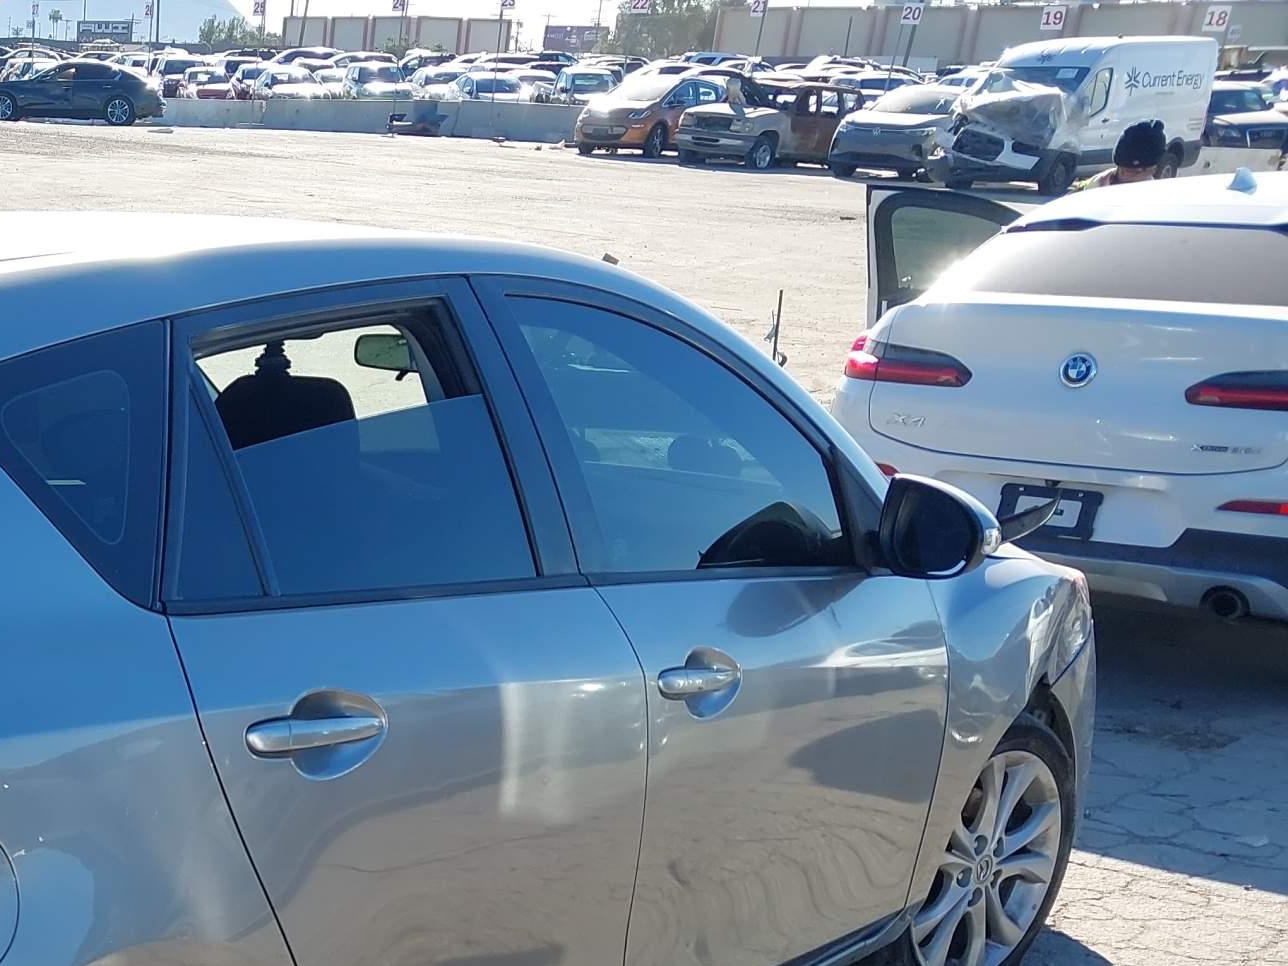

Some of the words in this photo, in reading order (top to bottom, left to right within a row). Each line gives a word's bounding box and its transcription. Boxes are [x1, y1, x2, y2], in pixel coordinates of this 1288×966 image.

[902, 6, 922, 20] 20
[1042, 10, 1064, 26] 19
[1205, 10, 1228, 26] 18
[1142, 71, 1176, 88] Current
[1176, 70, 1204, 90] Energy
